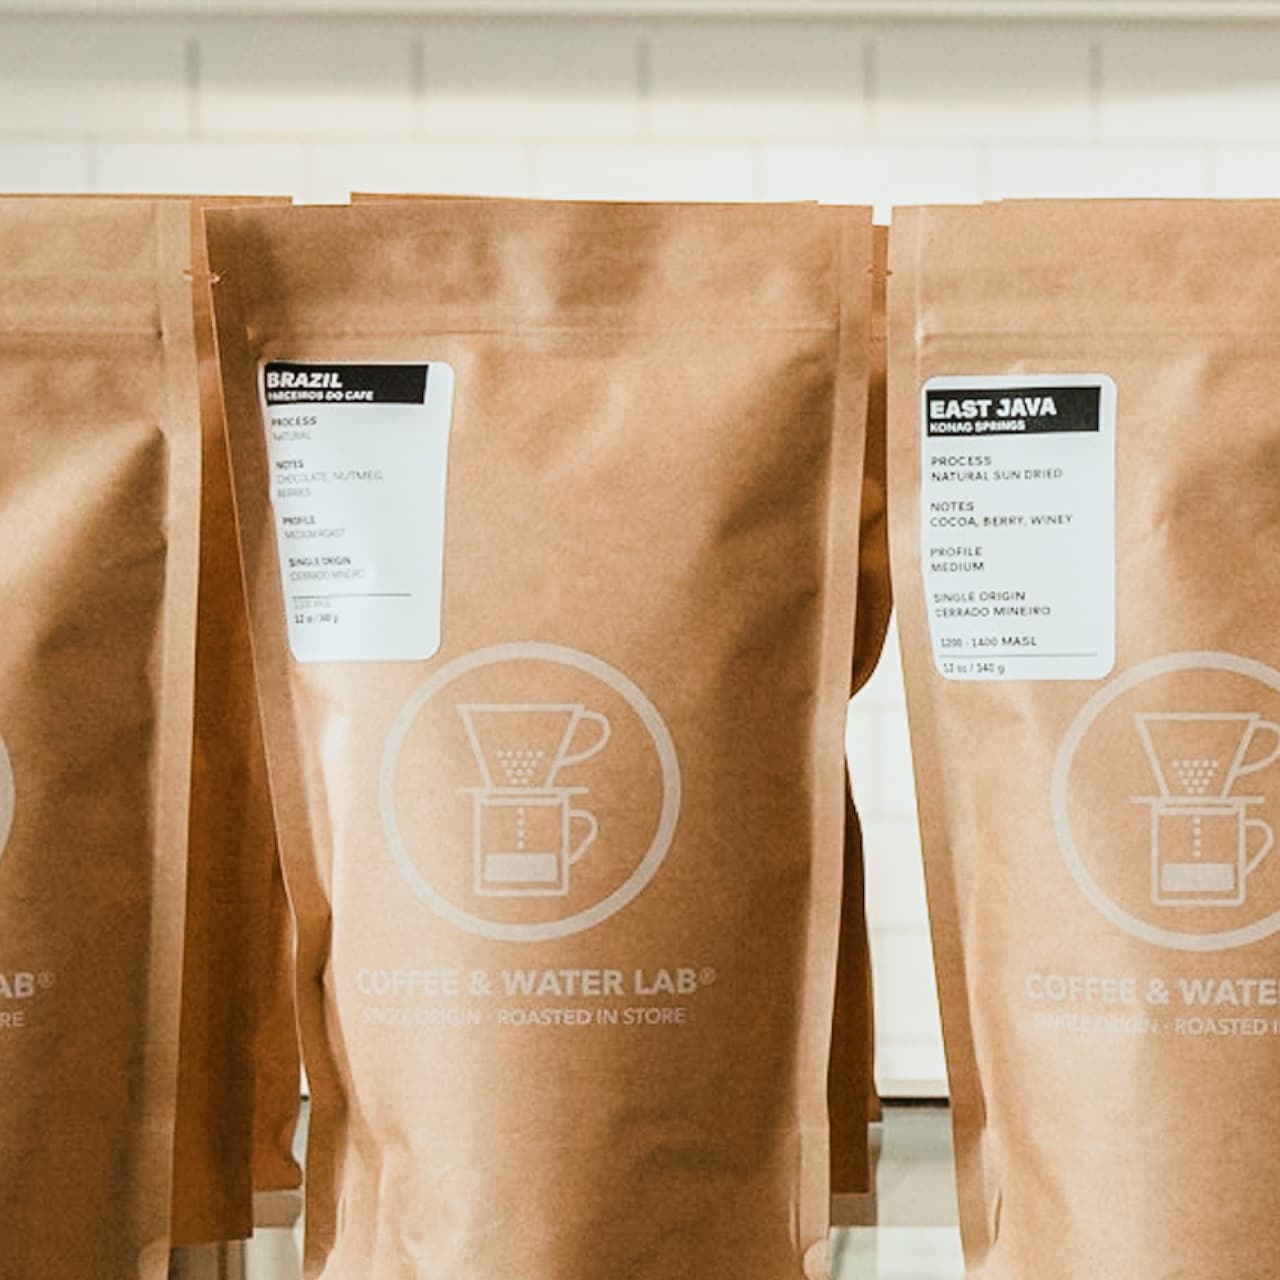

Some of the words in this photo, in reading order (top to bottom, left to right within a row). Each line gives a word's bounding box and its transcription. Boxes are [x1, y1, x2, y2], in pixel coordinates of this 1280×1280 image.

[266, 372, 343, 388] BRAZIL
[930, 399, 992, 419] EAST
[996, 397, 1057, 417] JAVA
[975, 420, 1026, 432] SPRINGS
[930, 456, 992, 467] PROCESS
[930, 471, 989, 482] NATURAL
[993, 470, 1021, 481] SUN
[1025, 468, 1062, 480] DRIED
[930, 501, 975, 512] NOTES
[930, 546, 983, 557] PROFILE
[930, 561, 985, 572] MEDIUM
[934, 593, 975, 603] SINGLE
[979, 591, 1026, 601] ORIGIN
[356, 969, 460, 996] COFFEE
[469, 970, 491, 996] &
[501, 969, 624, 996] WATER
[1024, 974, 1137, 1003] COFFEE
[1145, 977, 1169, 1005] &
[499, 1008, 592, 1026] ROASTED
[596, 1008, 618, 1025] IN
[623, 1007, 686, 1025] STORE
[1174, 1018, 1269, 1036] ROASTED
